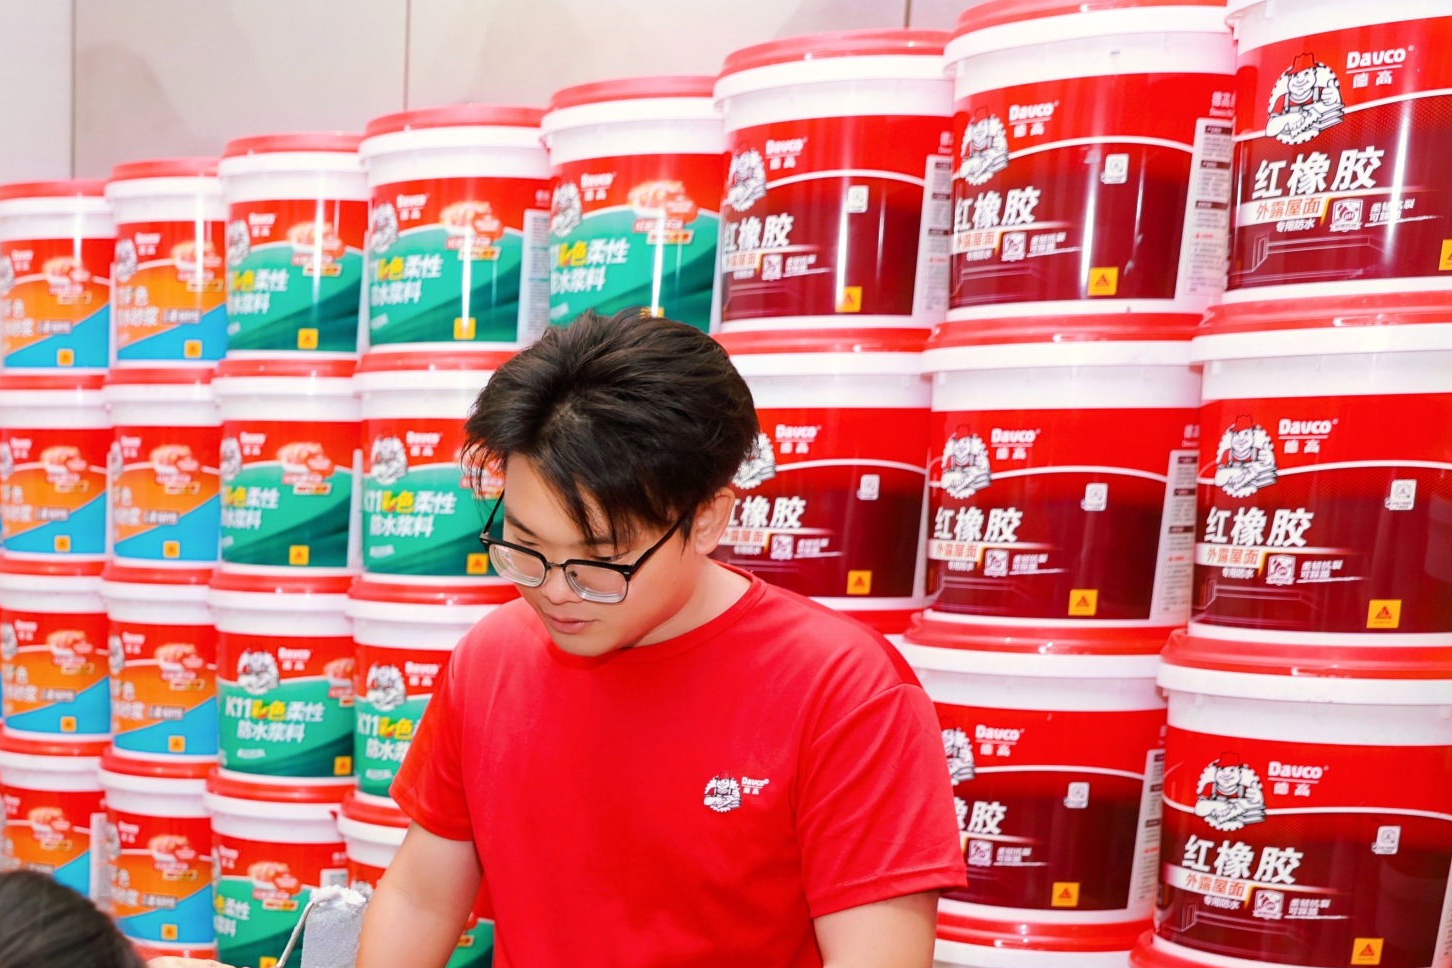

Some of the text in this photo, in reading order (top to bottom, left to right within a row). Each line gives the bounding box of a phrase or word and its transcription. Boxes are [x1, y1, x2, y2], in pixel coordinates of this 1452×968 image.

[1252, 145, 1385, 199] 红橡胶
[955, 186, 1041, 231] 红橡胶
[1255, 197, 1322, 220] 外露屋面
[1275, 218, 1315, 233] 专用防水
[934, 506, 1023, 542] 红橡胶
[1204, 507, 1314, 547] 红橡胶
[1182, 834, 1304, 885] 红橡胶
[1185, 873, 1245, 898] 外露屋面
